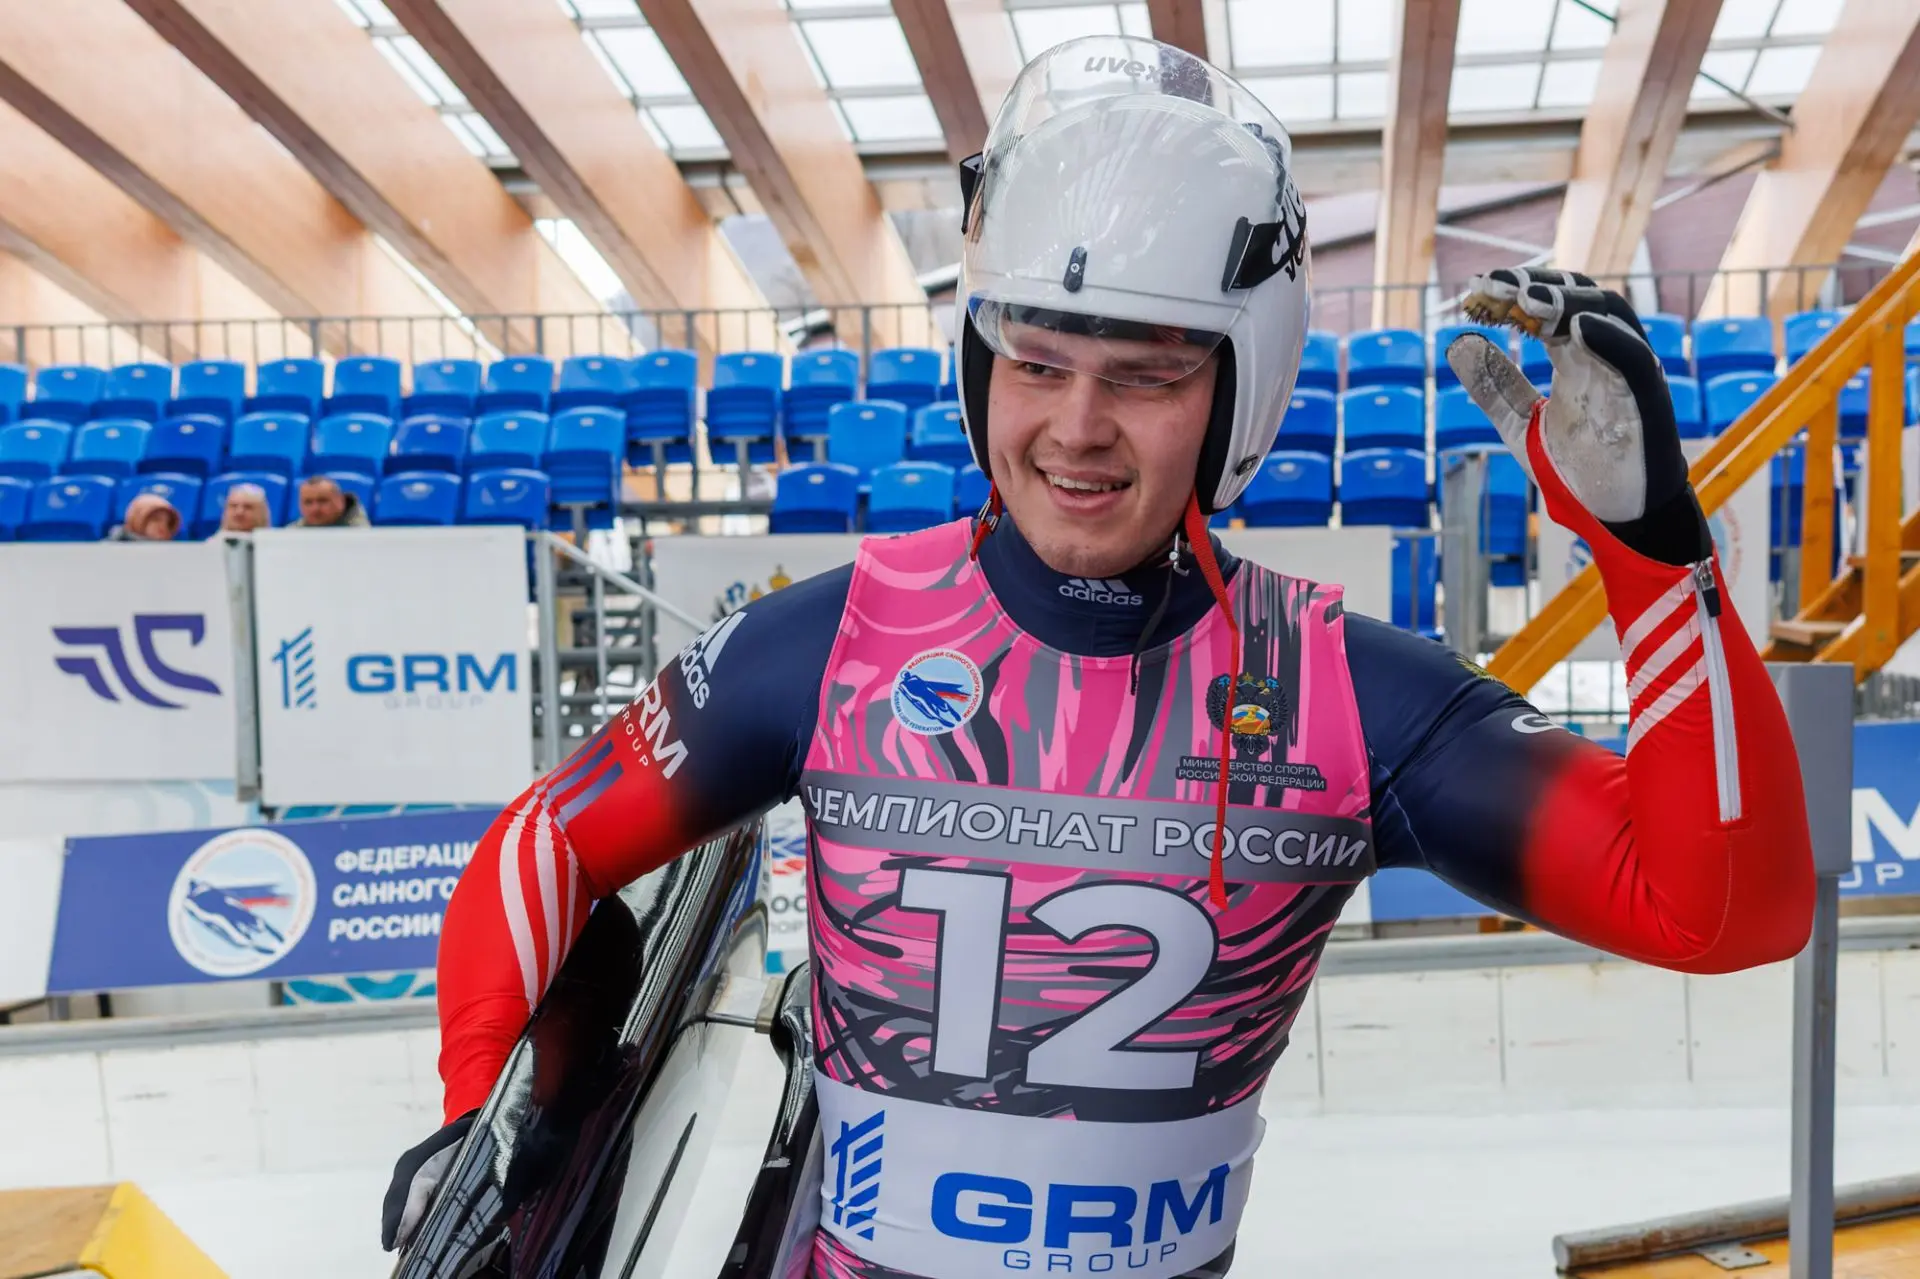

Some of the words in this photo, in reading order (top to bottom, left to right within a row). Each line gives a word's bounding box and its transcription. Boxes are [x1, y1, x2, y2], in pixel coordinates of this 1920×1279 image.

[1084, 56, 1167, 84] uvex
[1058, 584, 1144, 606] adidas
[346, 653, 517, 693] GRM
[619, 704, 649, 767] ROUP
[634, 677, 689, 780] RM
[1178, 769, 1257, 782] РОССИСКОЙ
[1259, 776, 1325, 789] ФЕДЕРАЦИИ
[1182, 758, 1272, 773] МИНИСЕРСТВО
[1274, 764, 1318, 776] СПОРТА
[806, 785, 1138, 853] ЧЕМПИОНАТ
[1153, 818, 1368, 867] РОССИИ
[334, 840, 480, 875] ФЕДЕРАЦИ
[332, 875, 460, 908] САННОГО
[328, 911, 442, 942] РОССИИ
[899, 866, 1219, 1091] 12
[930, 1163, 1230, 1249] GRM
[1003, 1242, 1178, 1273] GROUP
